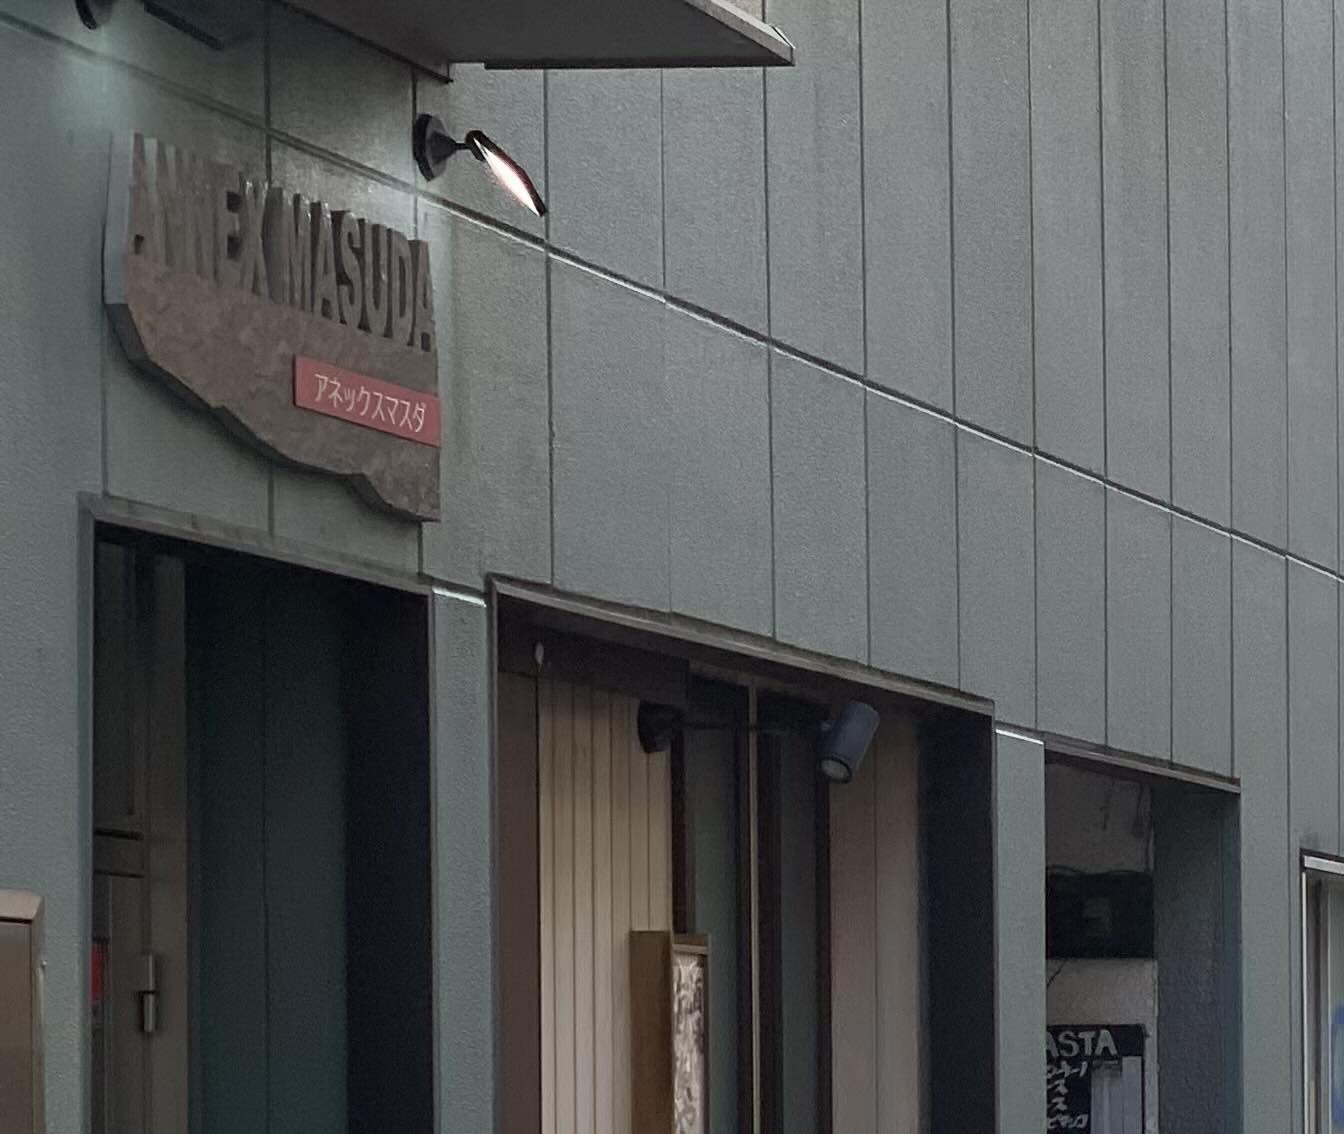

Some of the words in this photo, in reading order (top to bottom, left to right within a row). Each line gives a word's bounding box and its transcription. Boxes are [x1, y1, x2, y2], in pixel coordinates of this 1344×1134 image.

[290, 192, 438, 354] MASUDA
[313, 372, 427, 434] アネックスマスダ
